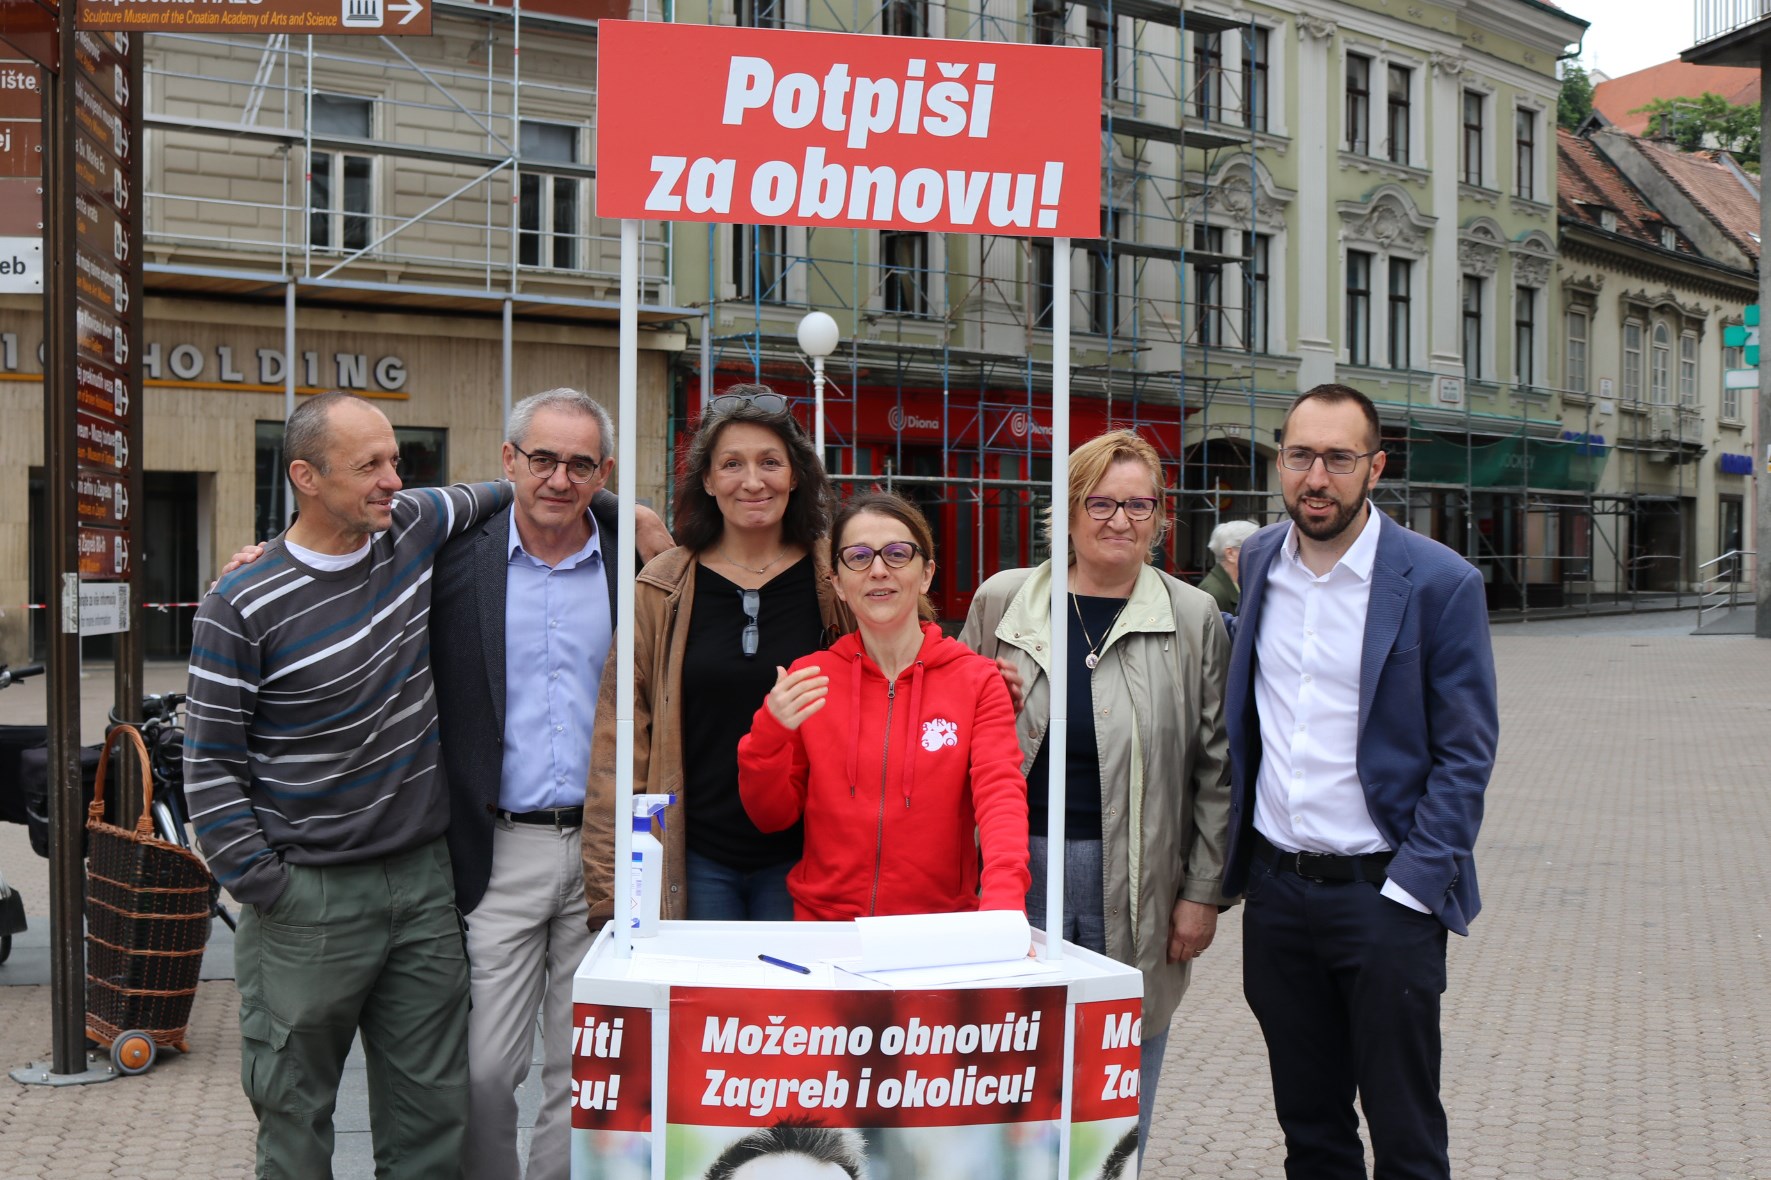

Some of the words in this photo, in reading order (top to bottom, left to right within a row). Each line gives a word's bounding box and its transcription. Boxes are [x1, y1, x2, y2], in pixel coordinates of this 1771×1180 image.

[83, 9, 122, 25] Sculpture
[124, 9, 159, 23] Museum
[161, 11, 170, 24] of
[171, 11, 184, 24] the
[186, 10, 220, 24] Croatian
[221, 11, 259, 27] Academy
[260, 12, 270, 25] of
[270, 11, 287, 25] Arts
[289, 12, 305, 26] and
[306, 12, 338, 26] Science
[2, 70, 36, 89] ište
[722, 55, 996, 149] Potpiši
[644, 155, 736, 213] za
[750, 146, 1064, 229] obnovu!
[143, 342, 407, 390] HOLDING
[701, 1015, 873, 1056] Možemo
[879, 1010, 1042, 1055] obnoviti
[701, 1068, 849, 1117] Zagreb
[855, 1067, 873, 1108] i
[877, 1065, 1036, 1108] okolicu!
[1101, 1063, 1140, 1104] Za
